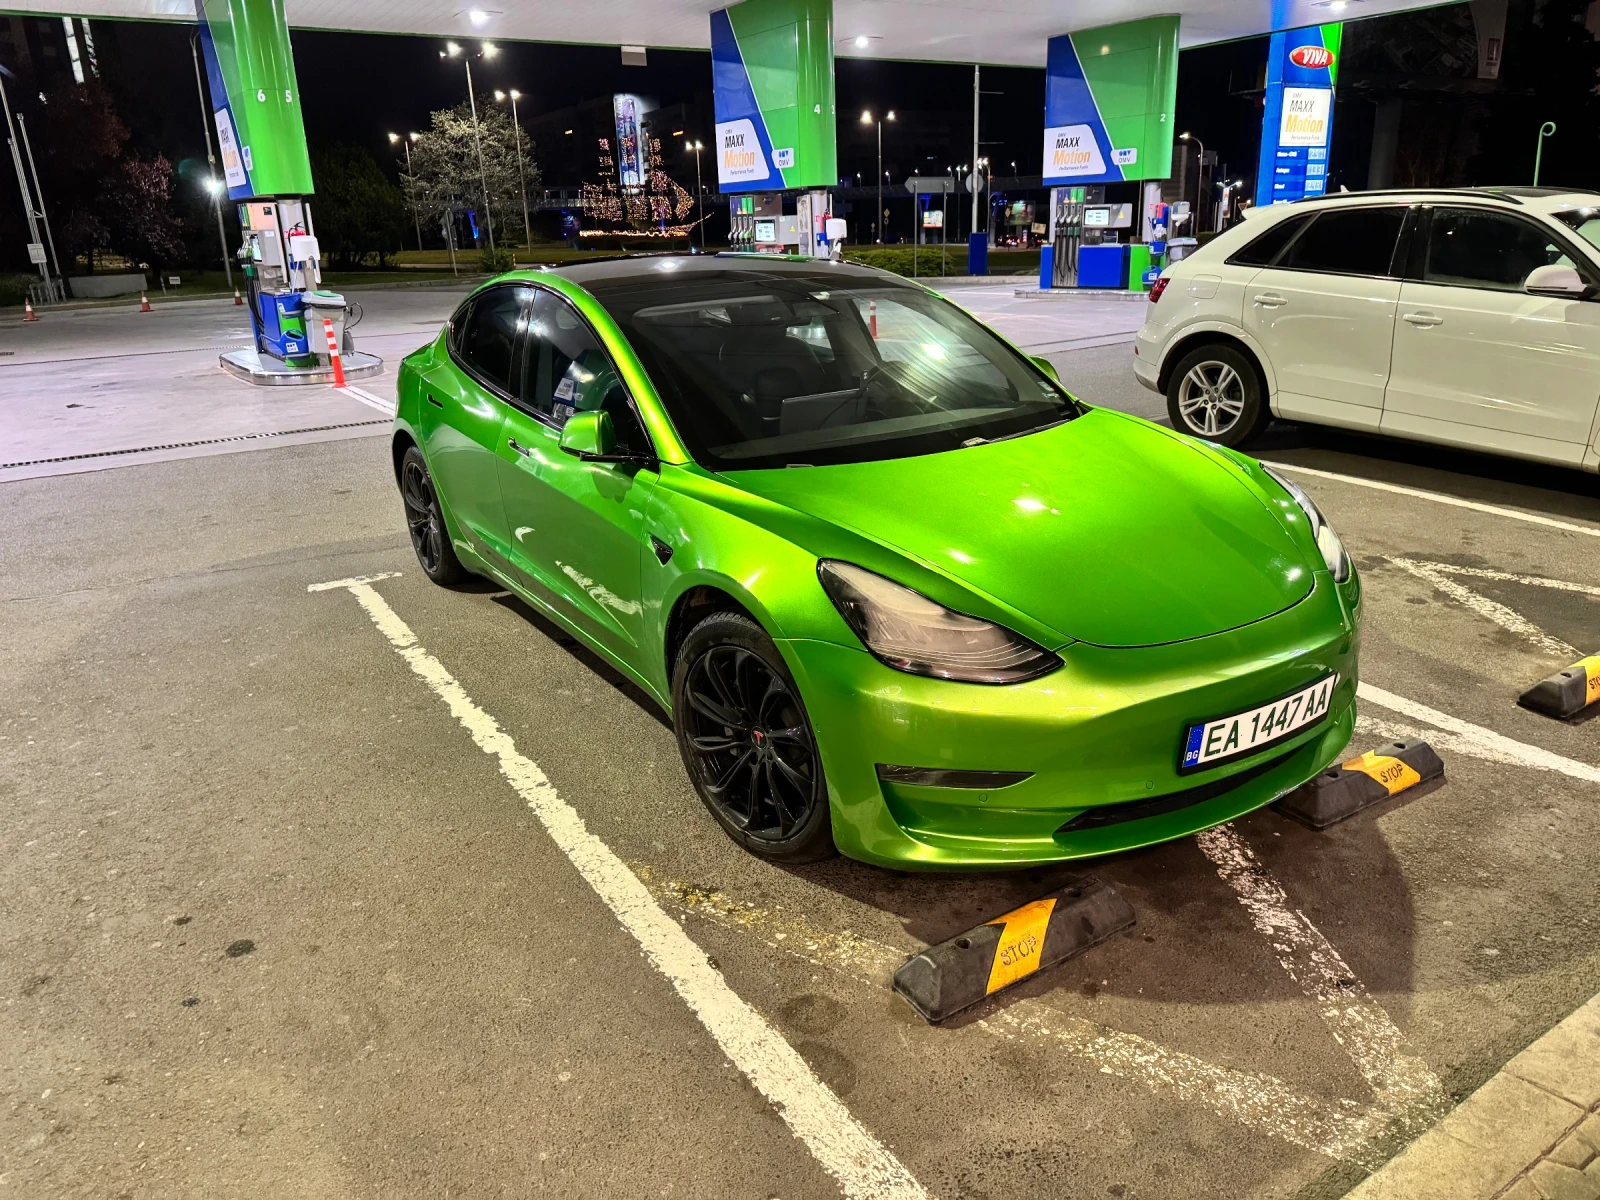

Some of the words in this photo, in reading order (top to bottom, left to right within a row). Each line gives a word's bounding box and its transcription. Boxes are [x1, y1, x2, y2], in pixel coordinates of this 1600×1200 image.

[1302, 48, 1328, 65] VIVA
[257, 89, 266, 102] 6
[285, 89, 292, 103] 5
[814, 104, 821, 114] 4
[1290, 100, 1314, 112] MAXX
[1160, 113, 1166, 122] 2
[1285, 114, 1323, 133] Motion
[725, 134, 744, 148] MAXX
[1056, 137, 1080, 149] MAXX
[725, 148, 754, 168] Motion
[1053, 149, 1091, 165] Motion
[1204, 719, 1239, 758] EA
[1251, 695, 1304, 743] 1447
[1302, 683, 1328, 721] AA
[1186, 750, 1198, 761] BG
[1380, 763, 1404, 783] STOP
[1001, 936, 1036, 966] STOP
